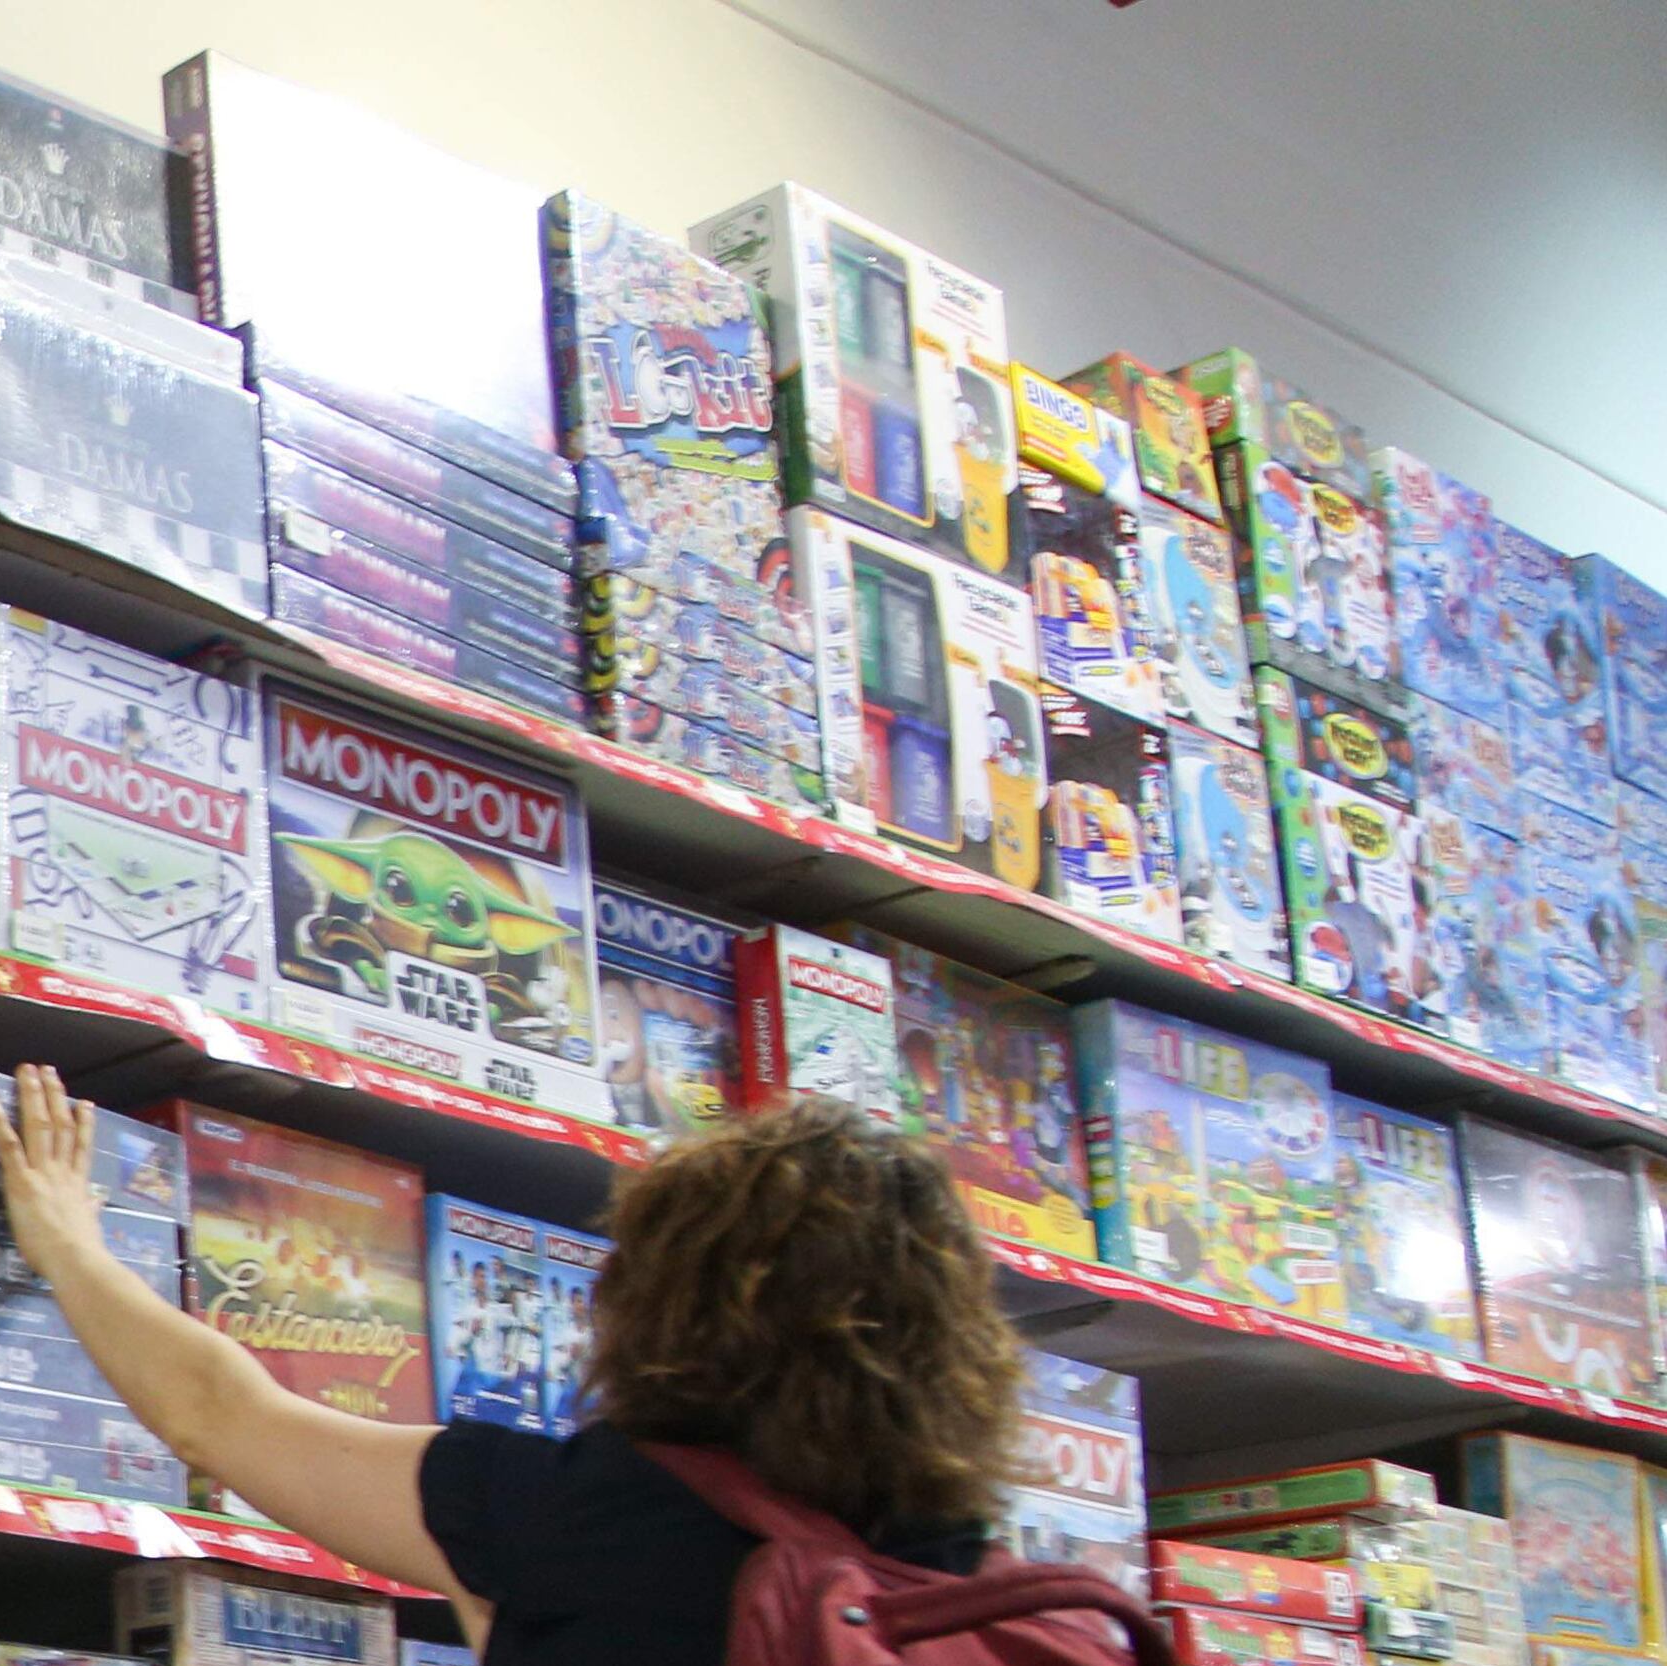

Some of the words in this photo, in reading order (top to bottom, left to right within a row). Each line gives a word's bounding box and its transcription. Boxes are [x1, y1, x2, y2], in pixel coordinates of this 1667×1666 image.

[28, 741, 242, 842] MONOPOLY
[283, 719, 562, 855] MONOPOLY
[598, 896, 735, 970] ONOPOL
[395, 964, 473, 1005] STAR
[398, 992, 481, 1034] WARS
[1154, 1028, 1247, 1101] LIFE
